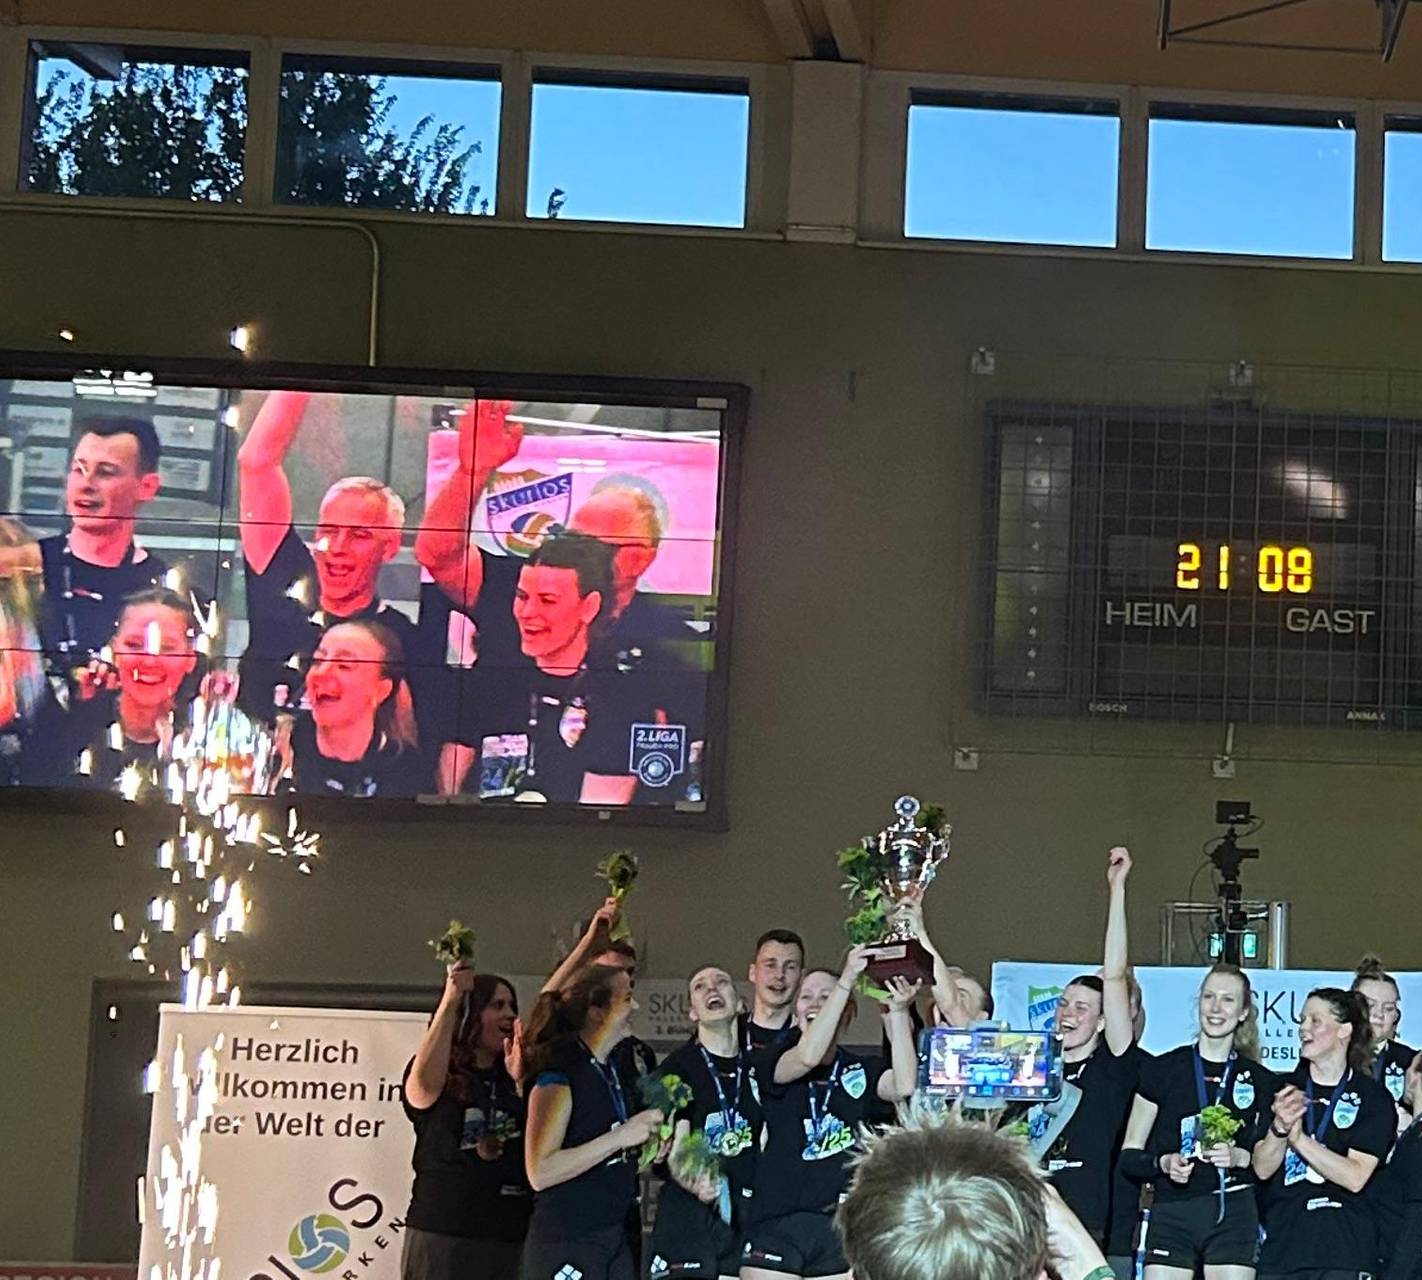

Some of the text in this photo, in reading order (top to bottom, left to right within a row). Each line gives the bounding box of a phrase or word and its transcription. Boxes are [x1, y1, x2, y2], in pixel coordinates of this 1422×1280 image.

[1106, 601, 1198, 628] HEIM
[1285, 607, 1376, 634] GAST
[231, 1036, 359, 1064] Herzlich
[255, 1111, 325, 1137] Welt
[335, 1112, 386, 1138] der
